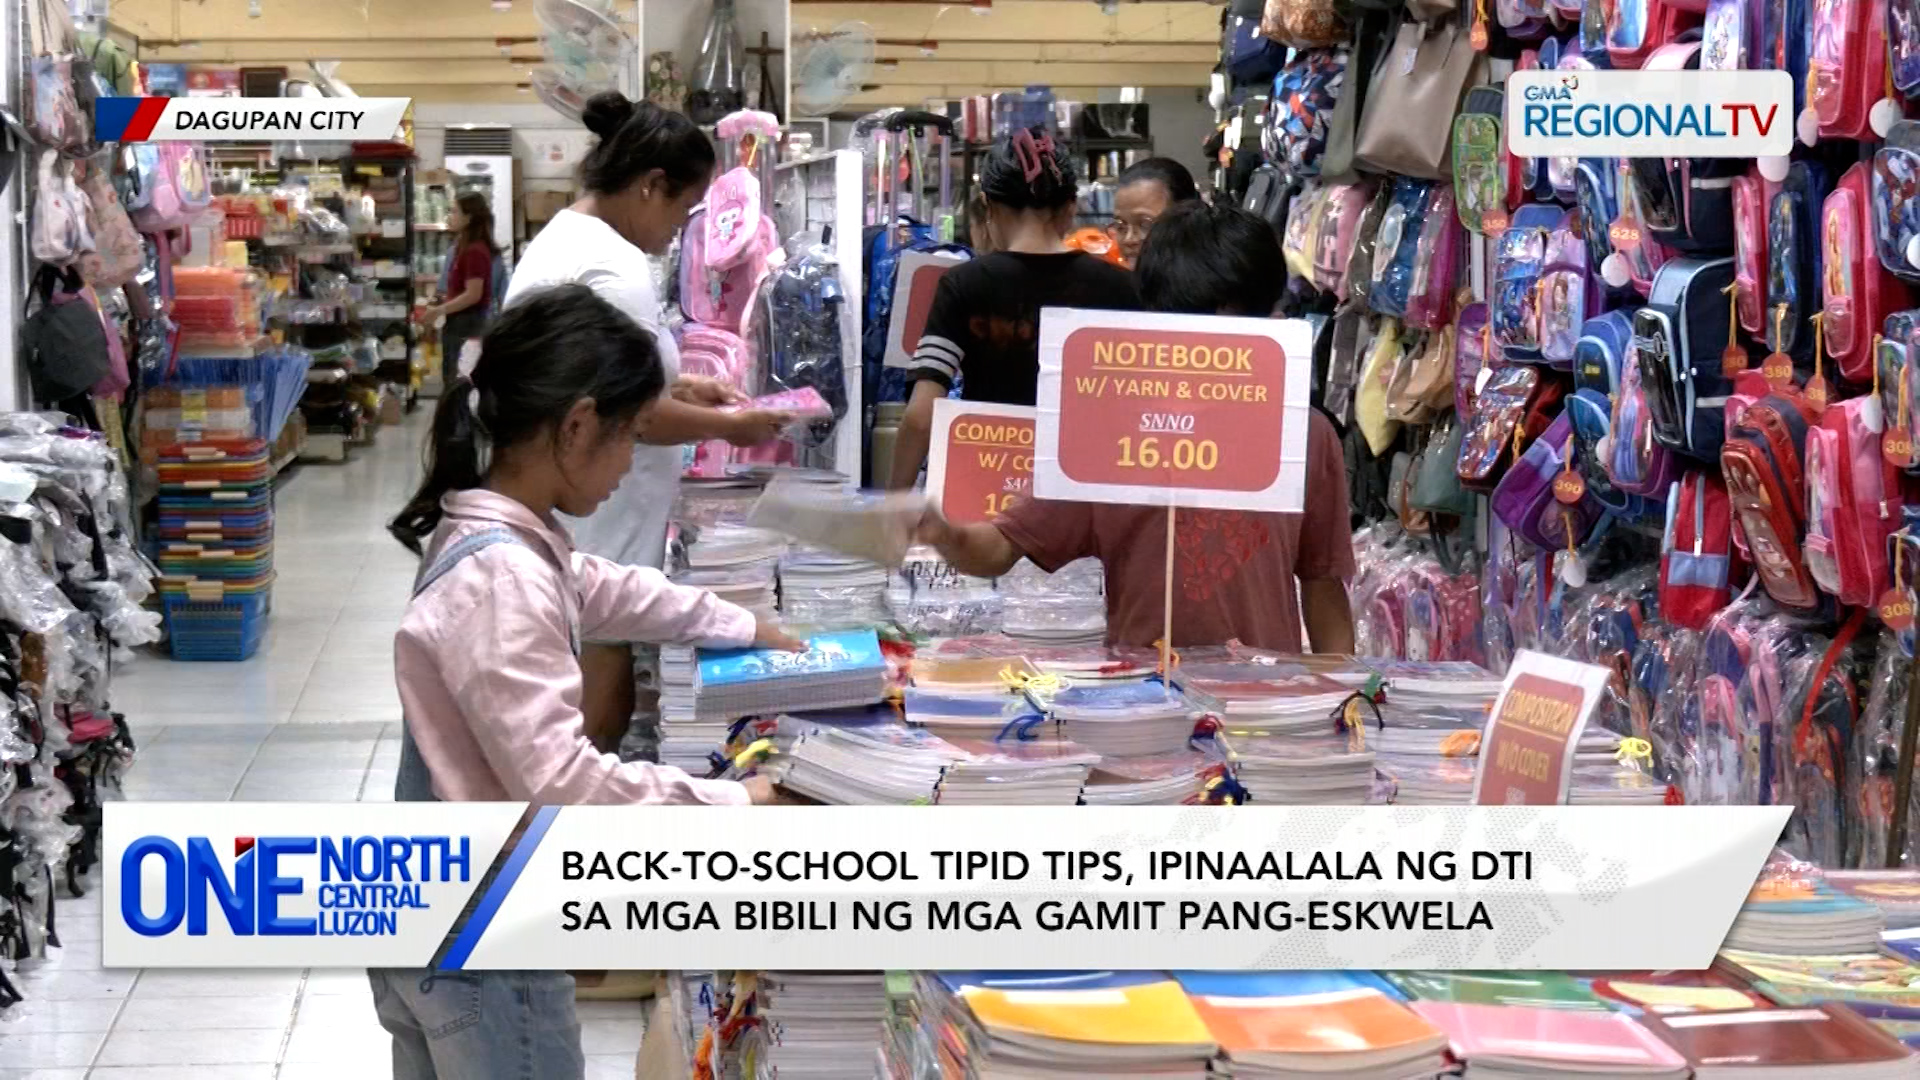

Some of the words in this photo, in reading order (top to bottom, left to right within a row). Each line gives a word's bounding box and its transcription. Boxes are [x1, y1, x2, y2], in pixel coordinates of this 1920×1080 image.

[1093, 341, 1254, 371] NOTEBOOK
[1075, 376, 1107, 398] W/
[1113, 379, 1169, 399] YARN
[1176, 381, 1192, 399] &
[1198, 383, 1267, 402] COVER
[1140, 413, 1195, 432] SNNO
[979, 452, 1008, 471] W/
[1116, 437, 1218, 470] 16.00
[1503, 689, 1577, 734] COMPOSITION
[1518, 747, 1549, 782] COVER
